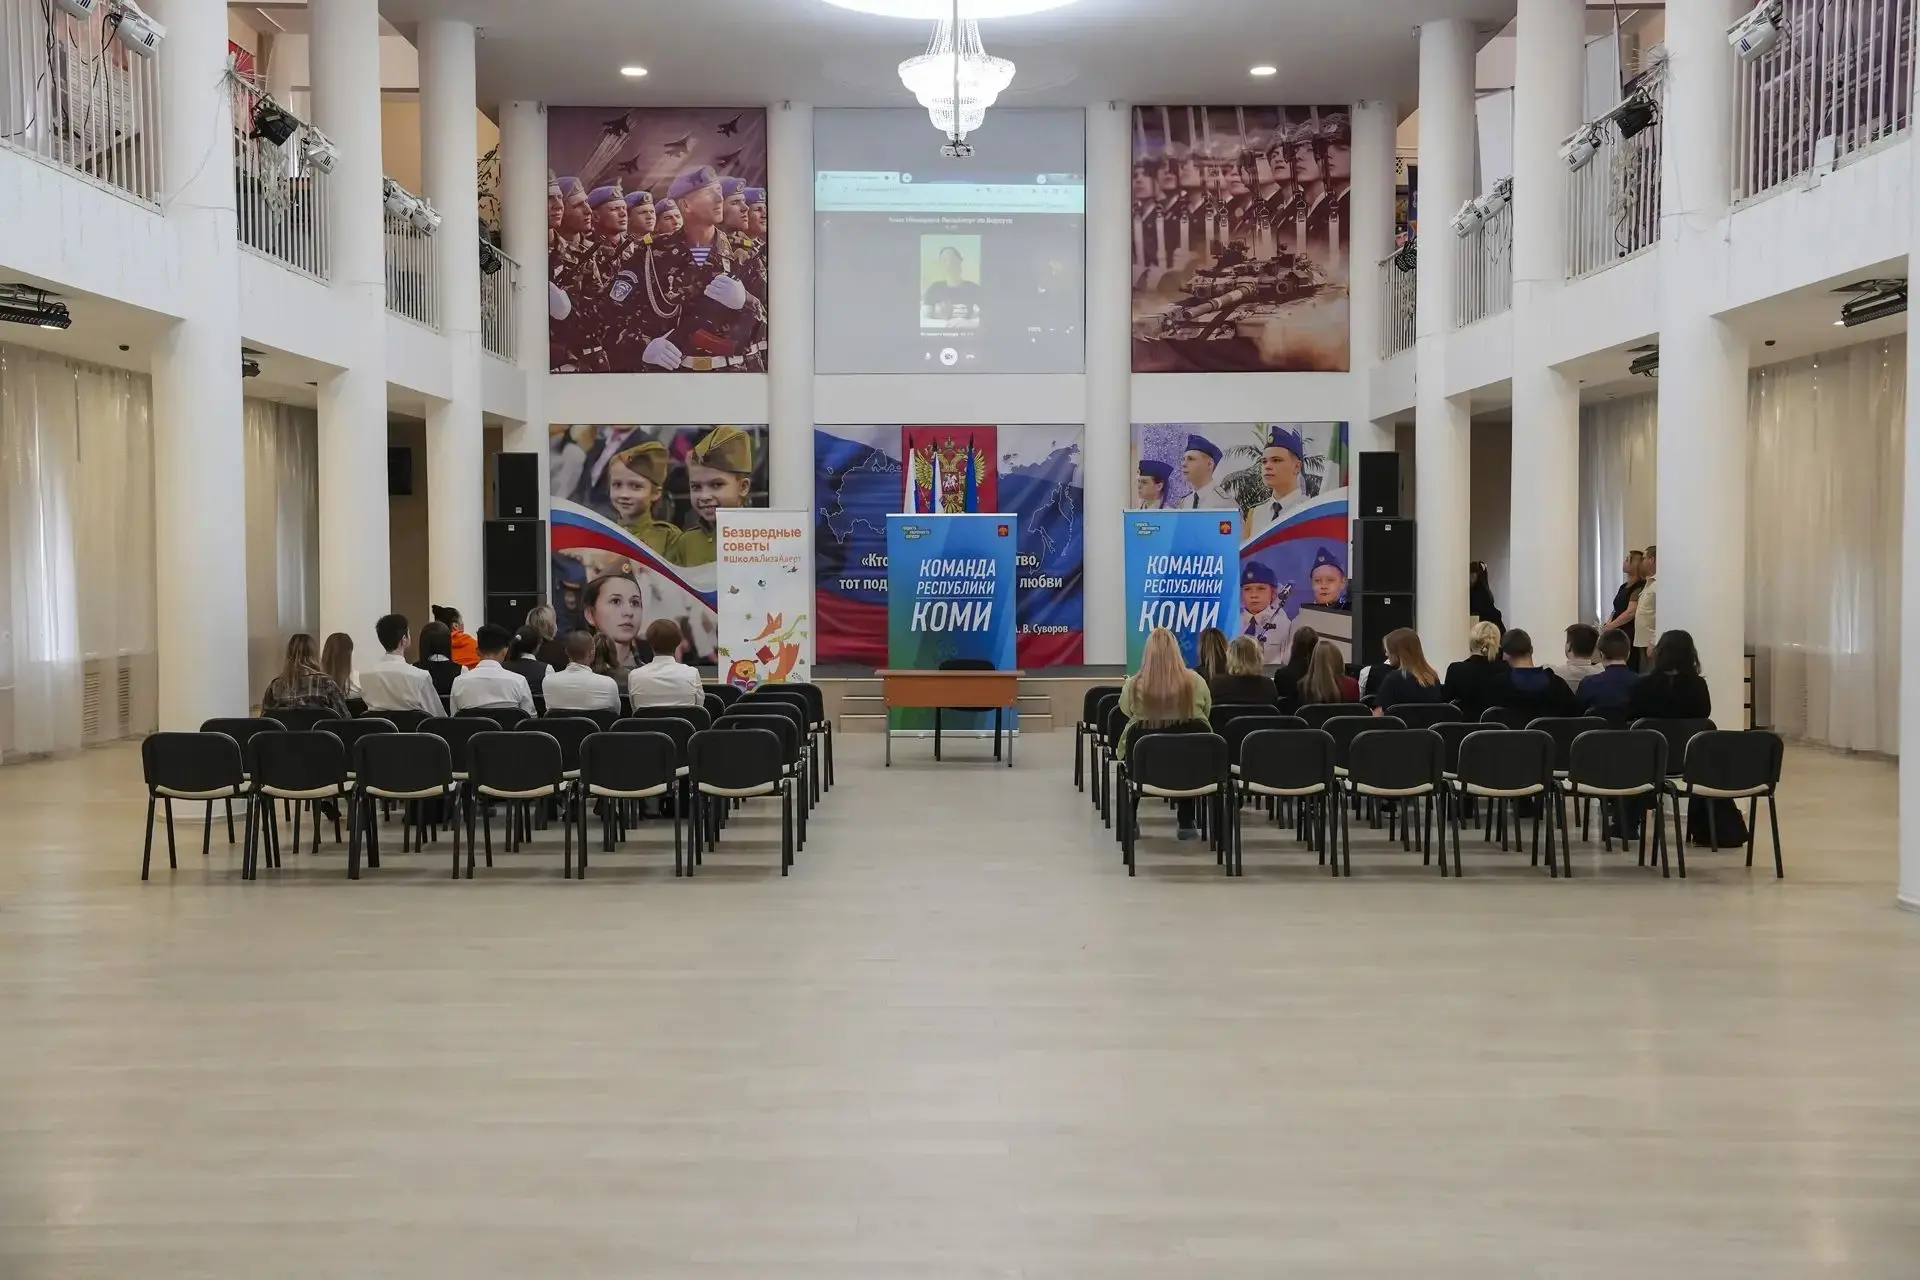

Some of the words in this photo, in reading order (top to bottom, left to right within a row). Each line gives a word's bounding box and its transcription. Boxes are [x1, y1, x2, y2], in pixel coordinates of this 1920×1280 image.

[722, 526, 802, 540] Безвредные
[723, 542, 769, 551] советы
[919, 559, 996, 579] КОМАНДА
[1015, 555, 1040, 568] тво,
[1146, 555, 1224, 577] КОМАНДА
[838, 579, 860, 590] тот
[863, 579, 888, 592] под
[1019, 574, 1063, 588] любви
[916, 580, 995, 595] РЕСПУБЛИКИ
[1143, 579, 1223, 594] РЕСПУБЛИКИ
[910, 601, 993, 632] КОМИ
[1138, 600, 1220, 633] КОМИ
[1032, 623, 1069, 635] Суворов
